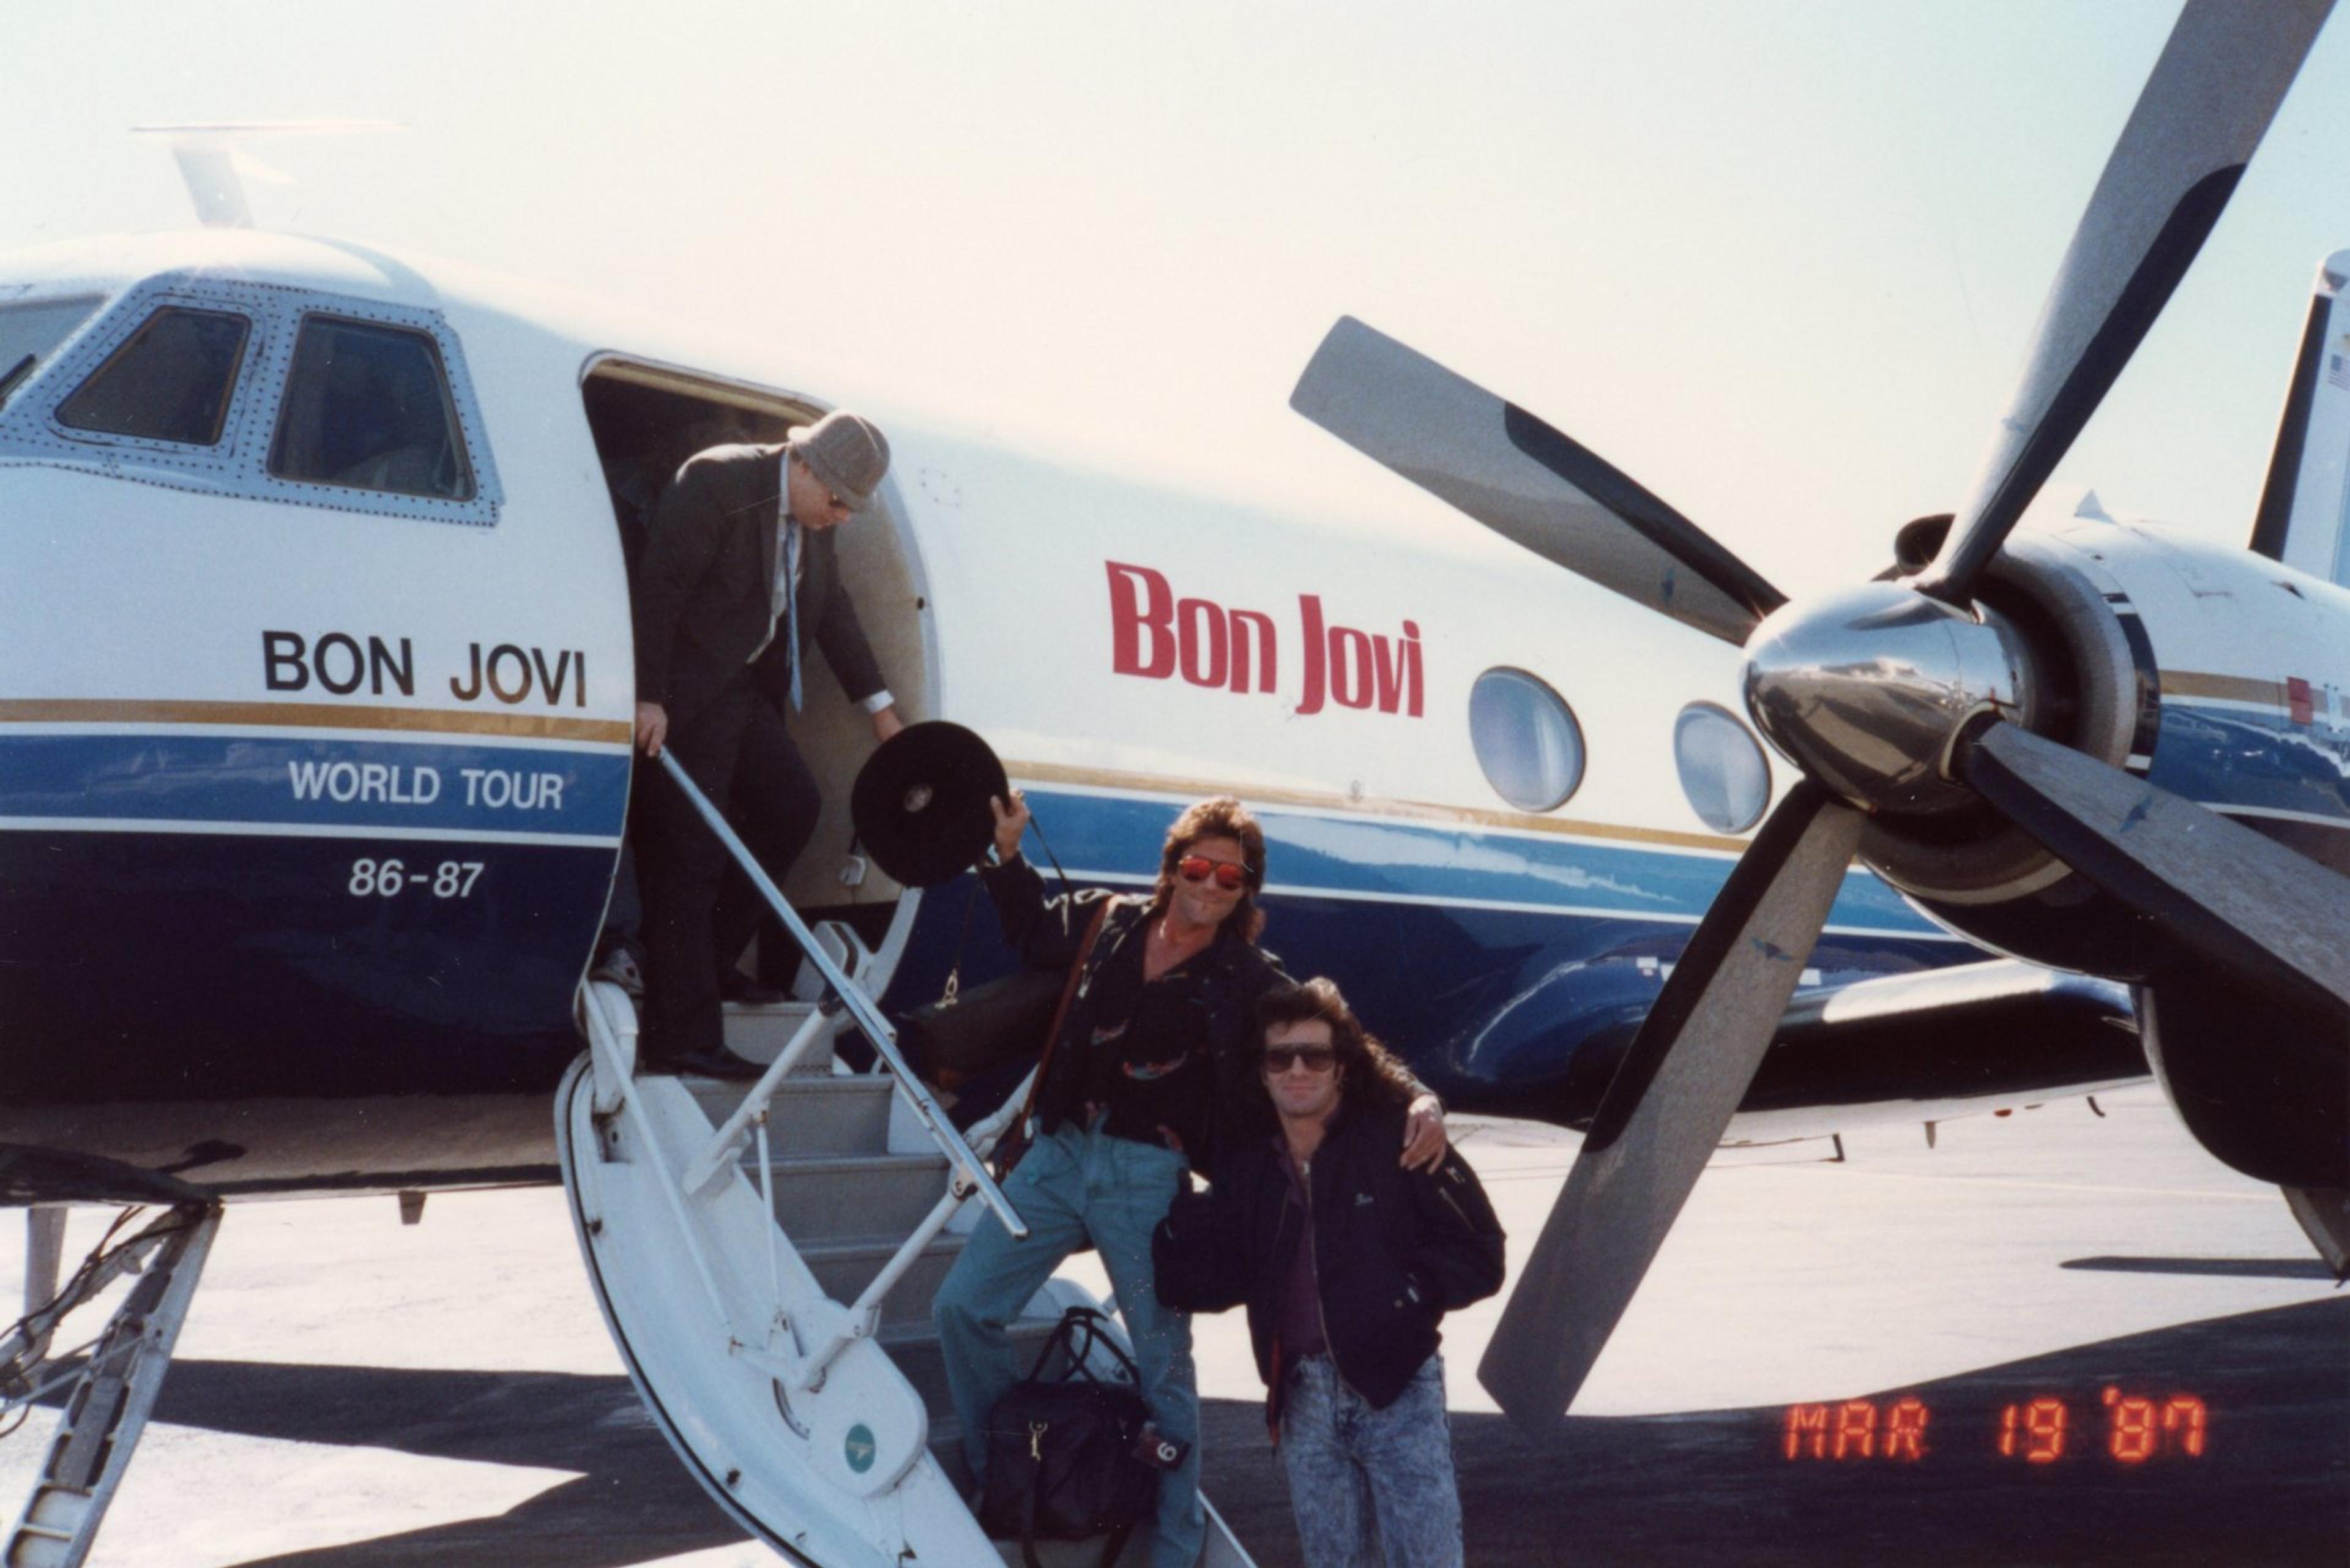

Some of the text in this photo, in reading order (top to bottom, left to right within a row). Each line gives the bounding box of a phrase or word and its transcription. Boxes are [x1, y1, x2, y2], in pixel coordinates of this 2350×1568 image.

[262, 630, 587, 708] BON JOVI
[1105, 561, 1423, 717] Bon Jovi
[289, 761, 563, 809] WORLD TOUR
[348, 858, 484, 898] 86-87
